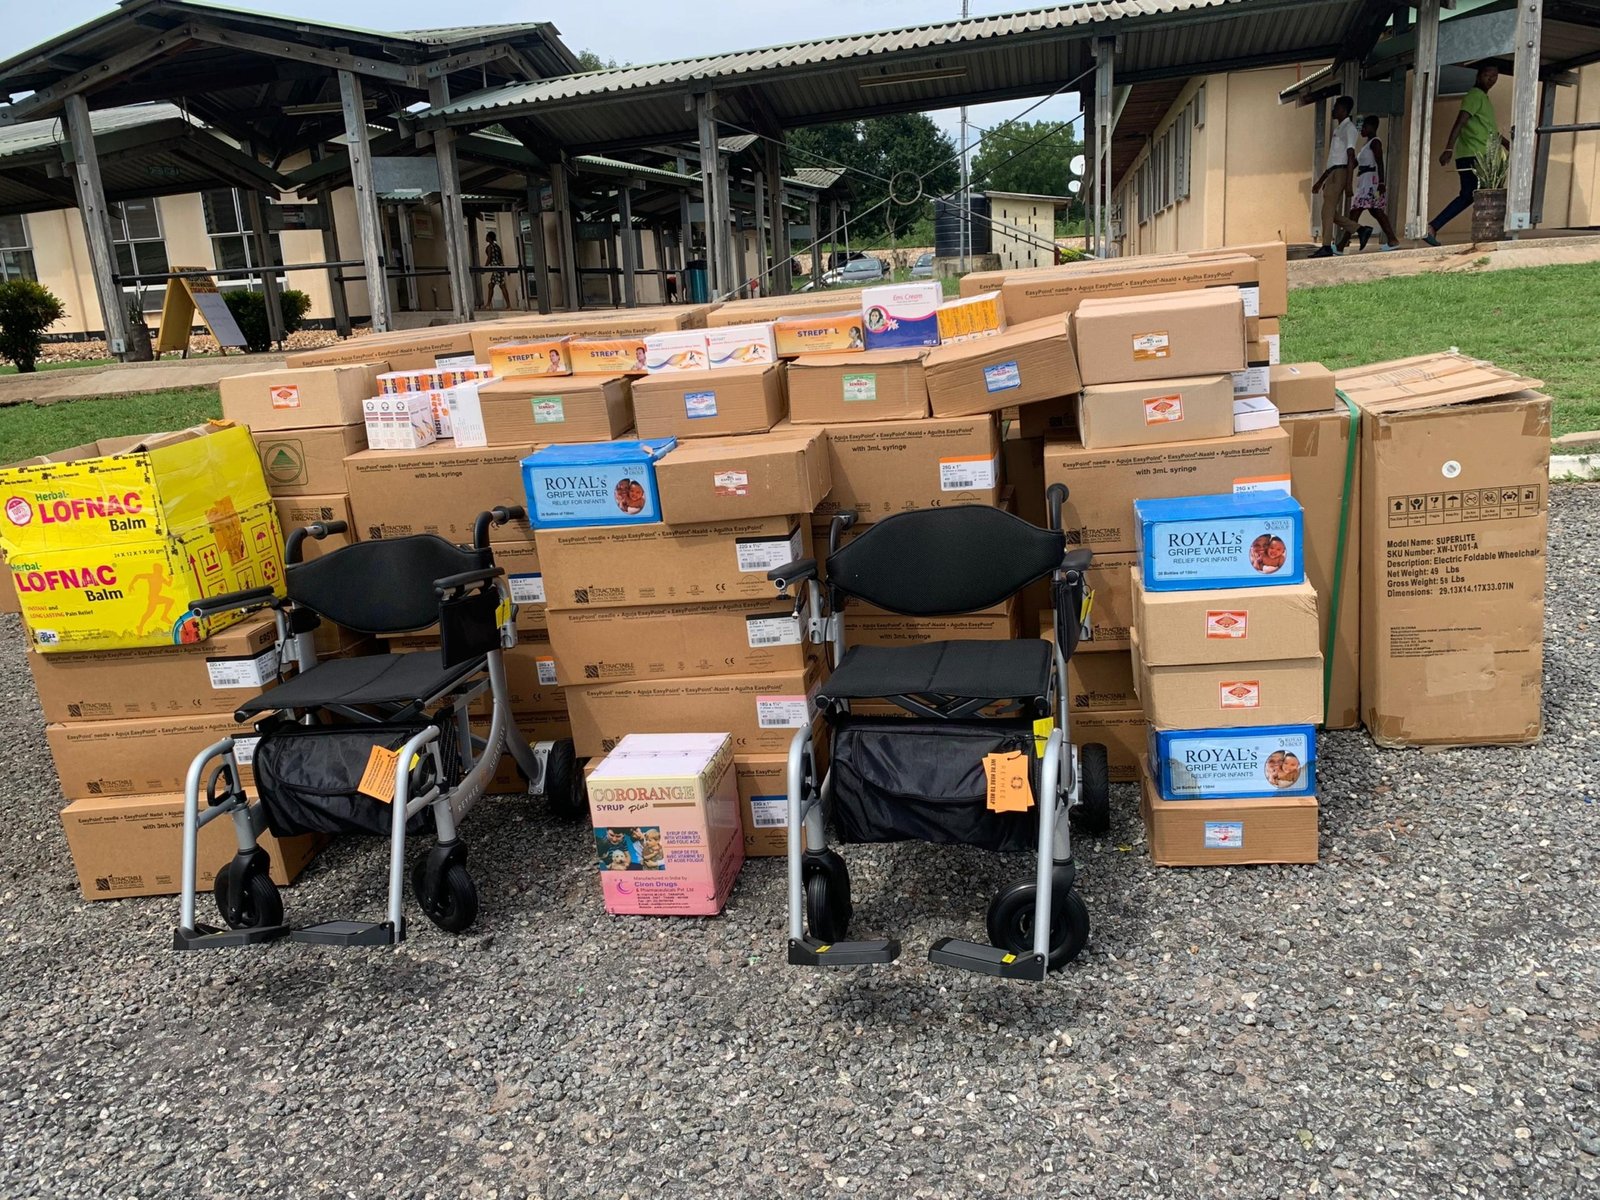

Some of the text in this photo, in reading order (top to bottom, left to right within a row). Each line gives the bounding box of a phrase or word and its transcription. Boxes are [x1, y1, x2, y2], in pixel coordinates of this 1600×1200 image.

[882, 444, 906, 452] syringe
[1135, 468, 1150, 476] with
[1169, 466, 1196, 474] syringe
[544, 476, 607, 490] ROYAL's
[546, 489, 609, 499] GRIPE WATER
[38, 492, 142, 524] LOFNAC
[109, 517, 146, 532] Balm
[1168, 531, 1242, 547] ROYAL's
[1387, 534, 1476, 548] Model Name: SUPERLITE
[1168, 546, 1242, 556] GRIPE WATER
[1387, 549, 1403, 558] SKU
[1404, 548, 1436, 557] Number:
[1387, 549, 1540, 568] Description: Electric Foldable Wheelchair
[14, 564, 117, 592] LOFNAC
[1387, 566, 1460, 578] Net Weight: 49 Lbs
[1387, 575, 1465, 588] Gross Weight: 58 Lbs
[84, 588, 124, 602] Balm
[1387, 588, 1433, 598] Dimensions:
[1185, 748, 1258, 763] ROYAL's
[1185, 762, 1258, 772] GRIPE WATER
[593, 786, 695, 802] CORORANGE
[628, 802, 649, 814] Plus
